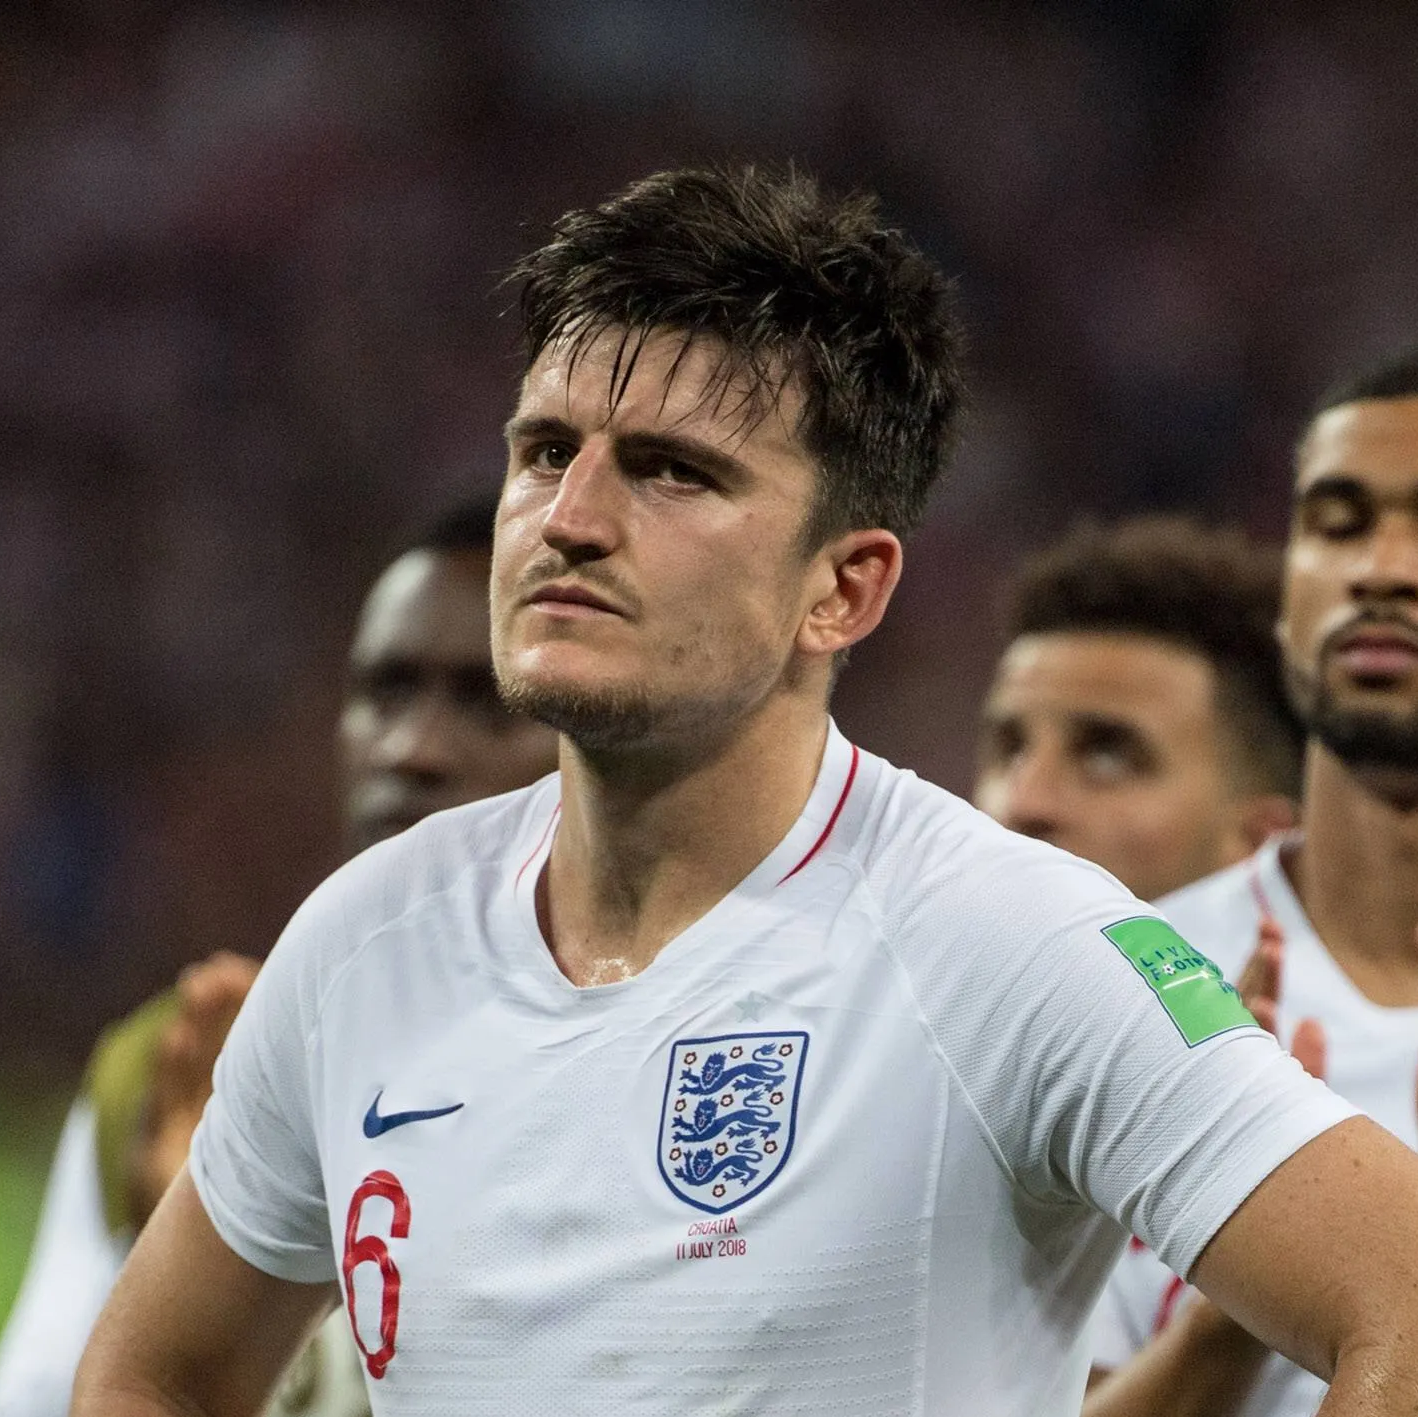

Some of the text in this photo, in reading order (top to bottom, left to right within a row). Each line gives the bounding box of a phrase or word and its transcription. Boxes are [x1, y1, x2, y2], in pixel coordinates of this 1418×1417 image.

[688, 1216, 738, 1236] CROATIA
[677, 1239, 747, 1260] 11 JULY 2018
[343, 1170, 411, 1379] 6
